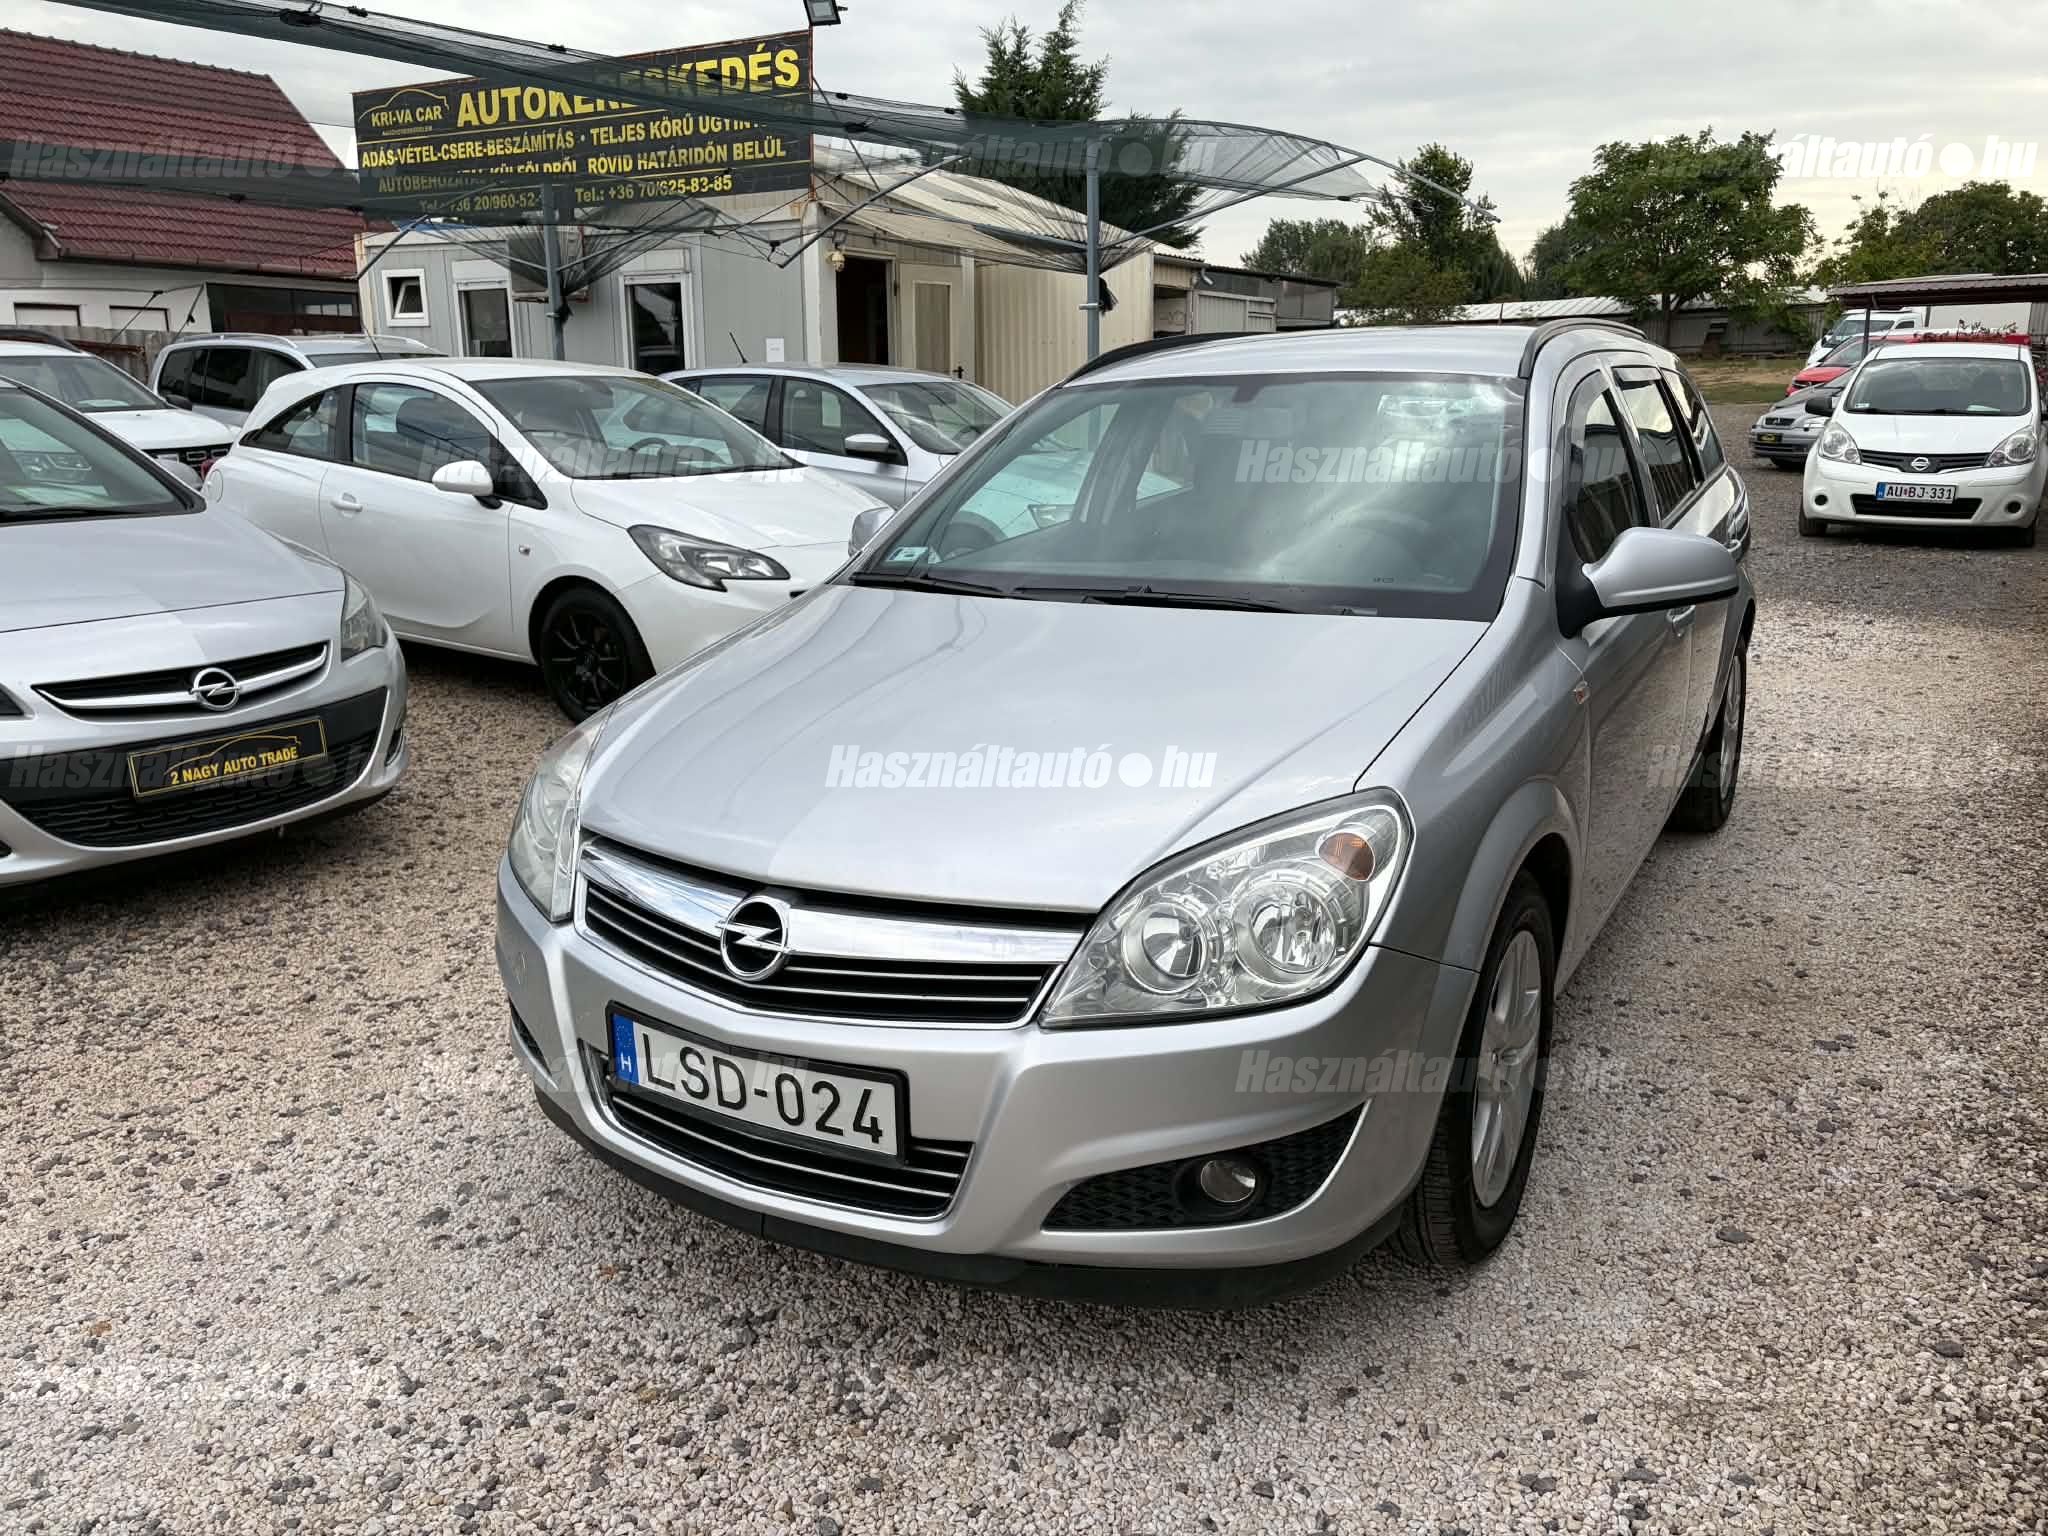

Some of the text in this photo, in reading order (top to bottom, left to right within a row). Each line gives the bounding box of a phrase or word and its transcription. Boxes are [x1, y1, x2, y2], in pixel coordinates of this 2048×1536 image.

[371, 105, 442, 128] KRI-VA CAR
[590, 121, 646, 146] TELJES
[587, 152, 634, 176] RÖVID
[637, 143, 728, 172] HATÁRIDŐN
[733, 135, 787, 162] BELÜL
[474, 190, 543, 210] 20/960-52-
[575, 174, 733, 204] Tel.: +36 70/625-83-85
[170, 770, 180, 785] 2
[182, 763, 219, 783] NAGY
[223, 756, 257, 775] AUTO
[261, 746, 299, 766] TRADE
[620, 1032, 883, 1144] H LSD-024
